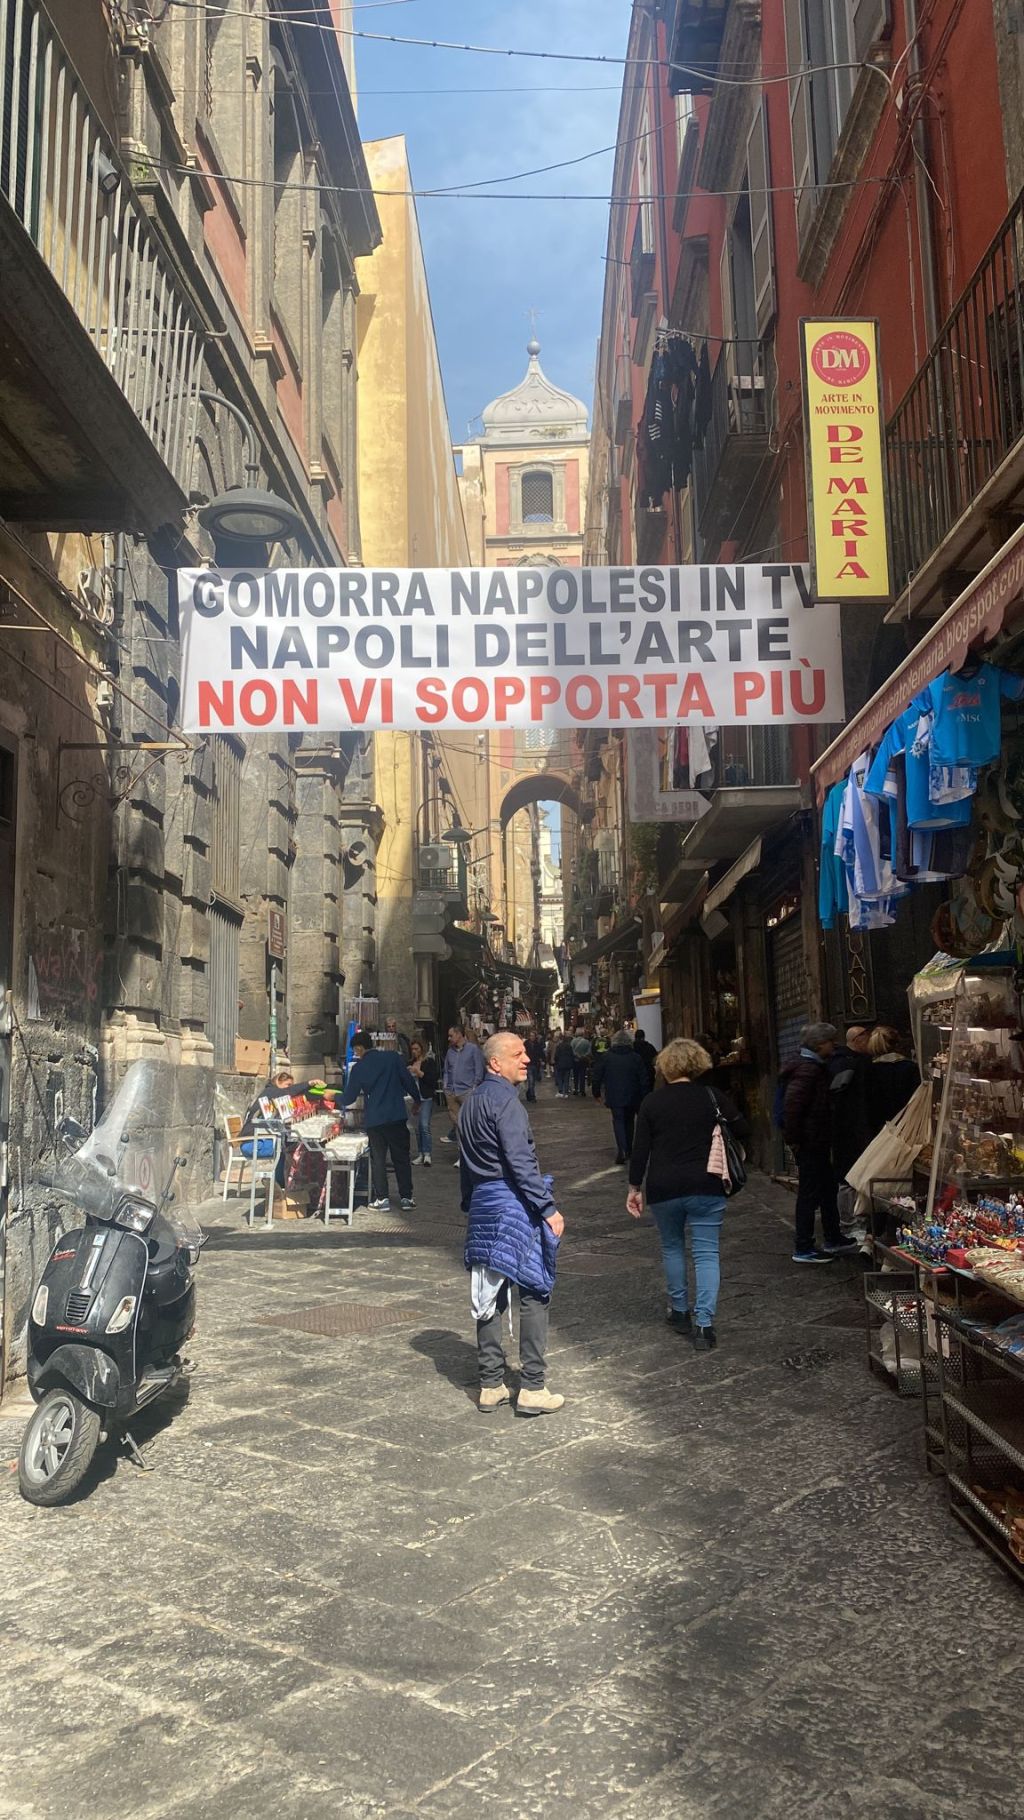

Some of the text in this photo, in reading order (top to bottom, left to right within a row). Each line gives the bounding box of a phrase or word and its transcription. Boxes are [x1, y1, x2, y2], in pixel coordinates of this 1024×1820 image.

[821, 348, 860, 369] DM
[815, 405, 875, 415] MOVIMENTO
[820, 393, 863, 403] ARTE IN
[826, 425, 870, 579] DE MARIA
[193, 571, 435, 618] GOMORRA
[451, 567, 680, 616] NAPOLESI
[700, 566, 745, 612] IN
[230, 618, 791, 671] NAPOLI DELL'ARTE
[198, 658, 826, 727] NON VI SOPPORTA PIÙ
